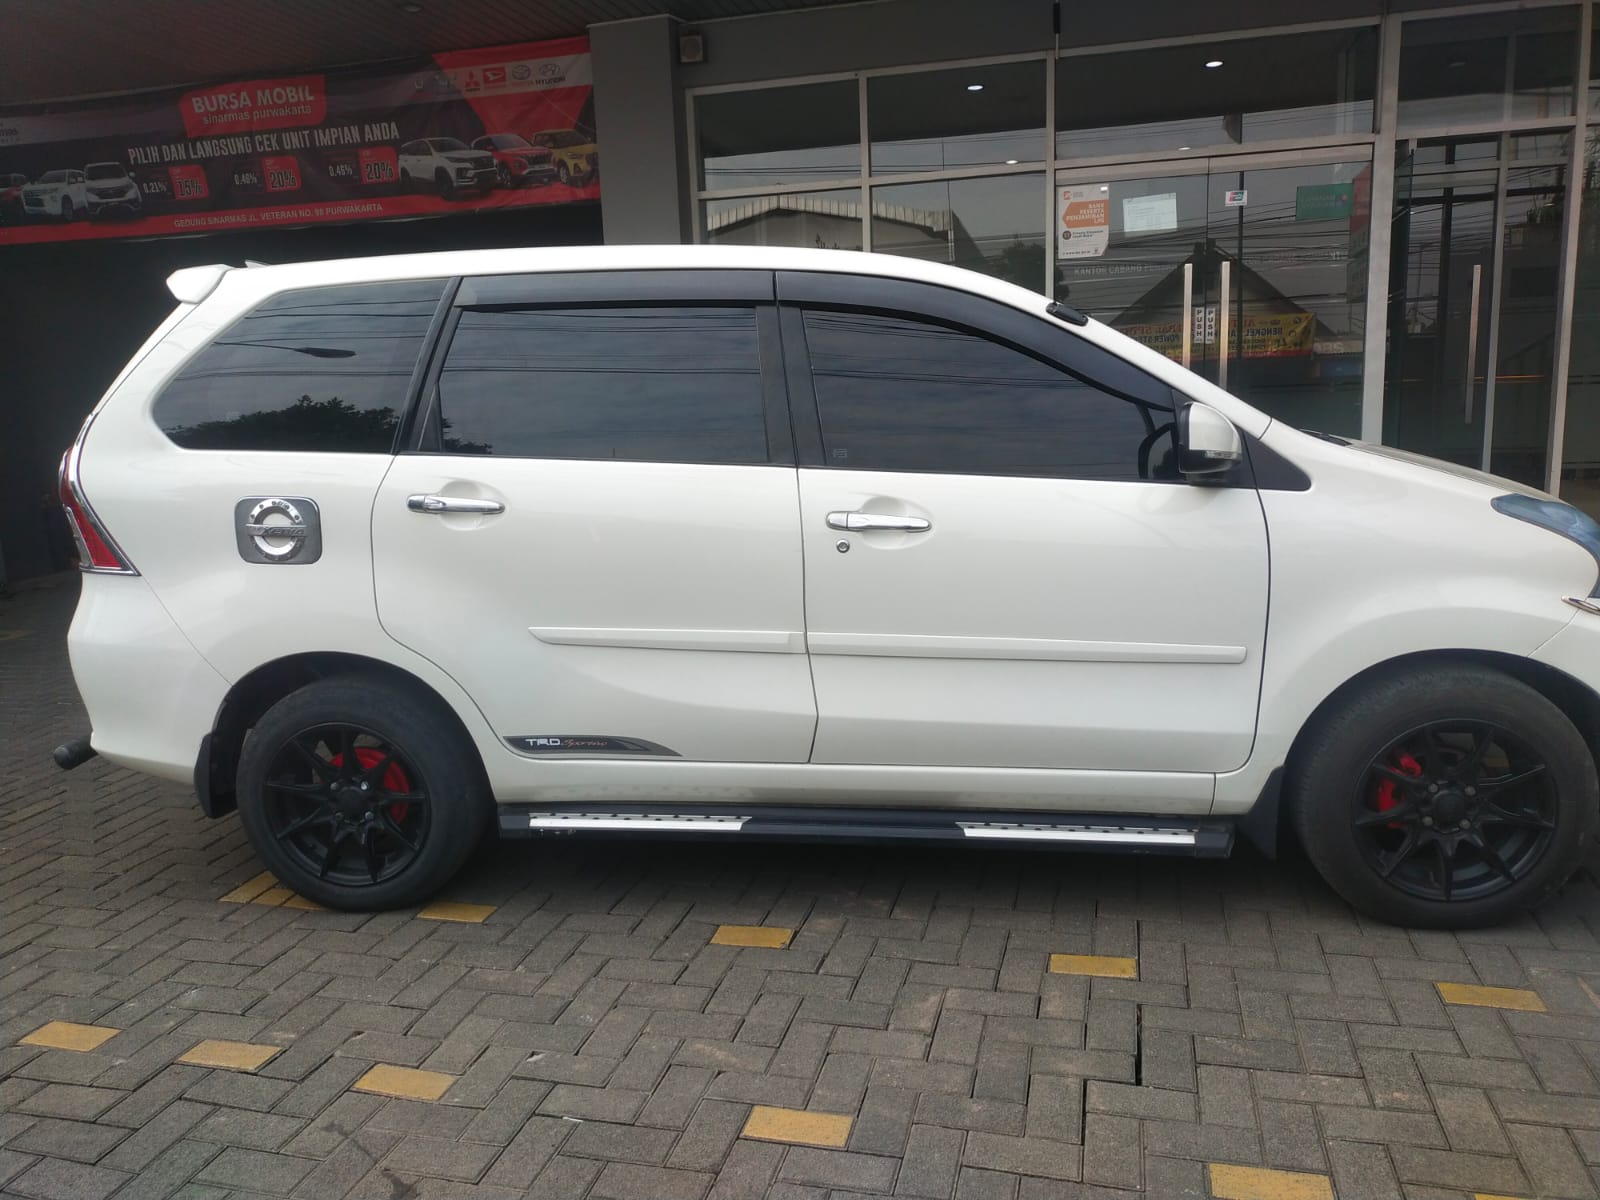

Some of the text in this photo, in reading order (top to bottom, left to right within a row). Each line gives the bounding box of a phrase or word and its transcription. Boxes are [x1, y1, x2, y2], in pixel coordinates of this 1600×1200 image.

[191, 85, 315, 113] BURSA MOBIL
[202, 104, 312, 125] sinarmas purwakarta
[128, 121, 400, 165] PILIH DAN LANGSUNG CEK UNIT IMPIAN ANDA
[269, 168, 297, 190] 20%
[366, 161, 394, 181] 20%
[174, 217, 206, 228] GEDUNG
[207, 214, 247, 226] SINARMAS
[260, 210, 298, 221] VETERAN
[326, 203, 383, 216] PURWAKARTA
[525, 738, 560, 746] TRD
